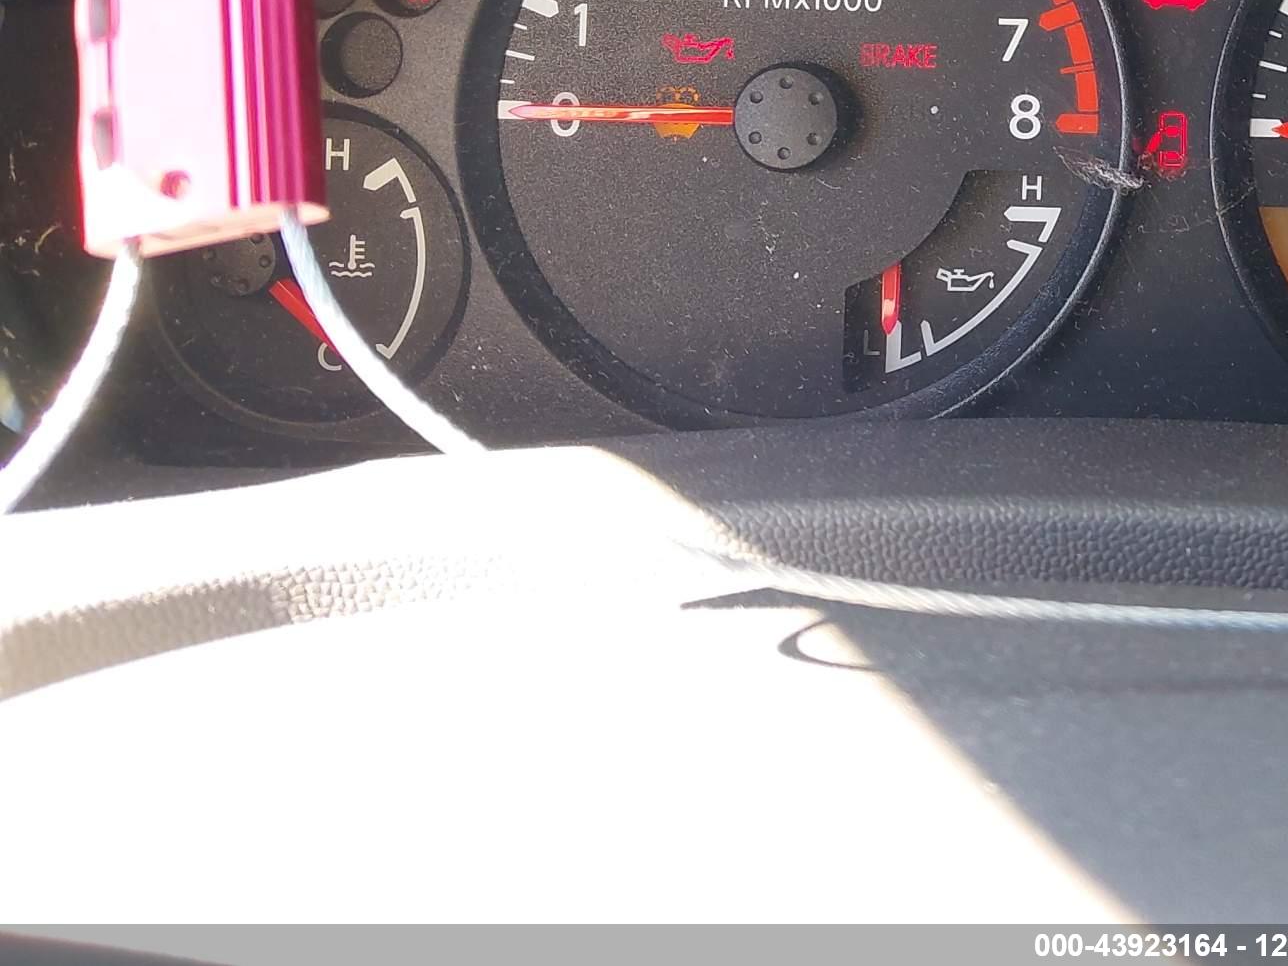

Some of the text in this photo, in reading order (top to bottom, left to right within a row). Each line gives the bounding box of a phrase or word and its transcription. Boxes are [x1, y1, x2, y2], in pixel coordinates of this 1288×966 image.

[573, 3, 588, 46] 1
[998, 18, 1029, 62] 7
[860, 42, 938, 68] BRAKE
[550, 92, 580, 137] 0
[1009, 94, 1041, 140] 8
[325, 137, 350, 171] H
[1021, 175, 1042, 201] H
[863, 330, 881, 356] L
